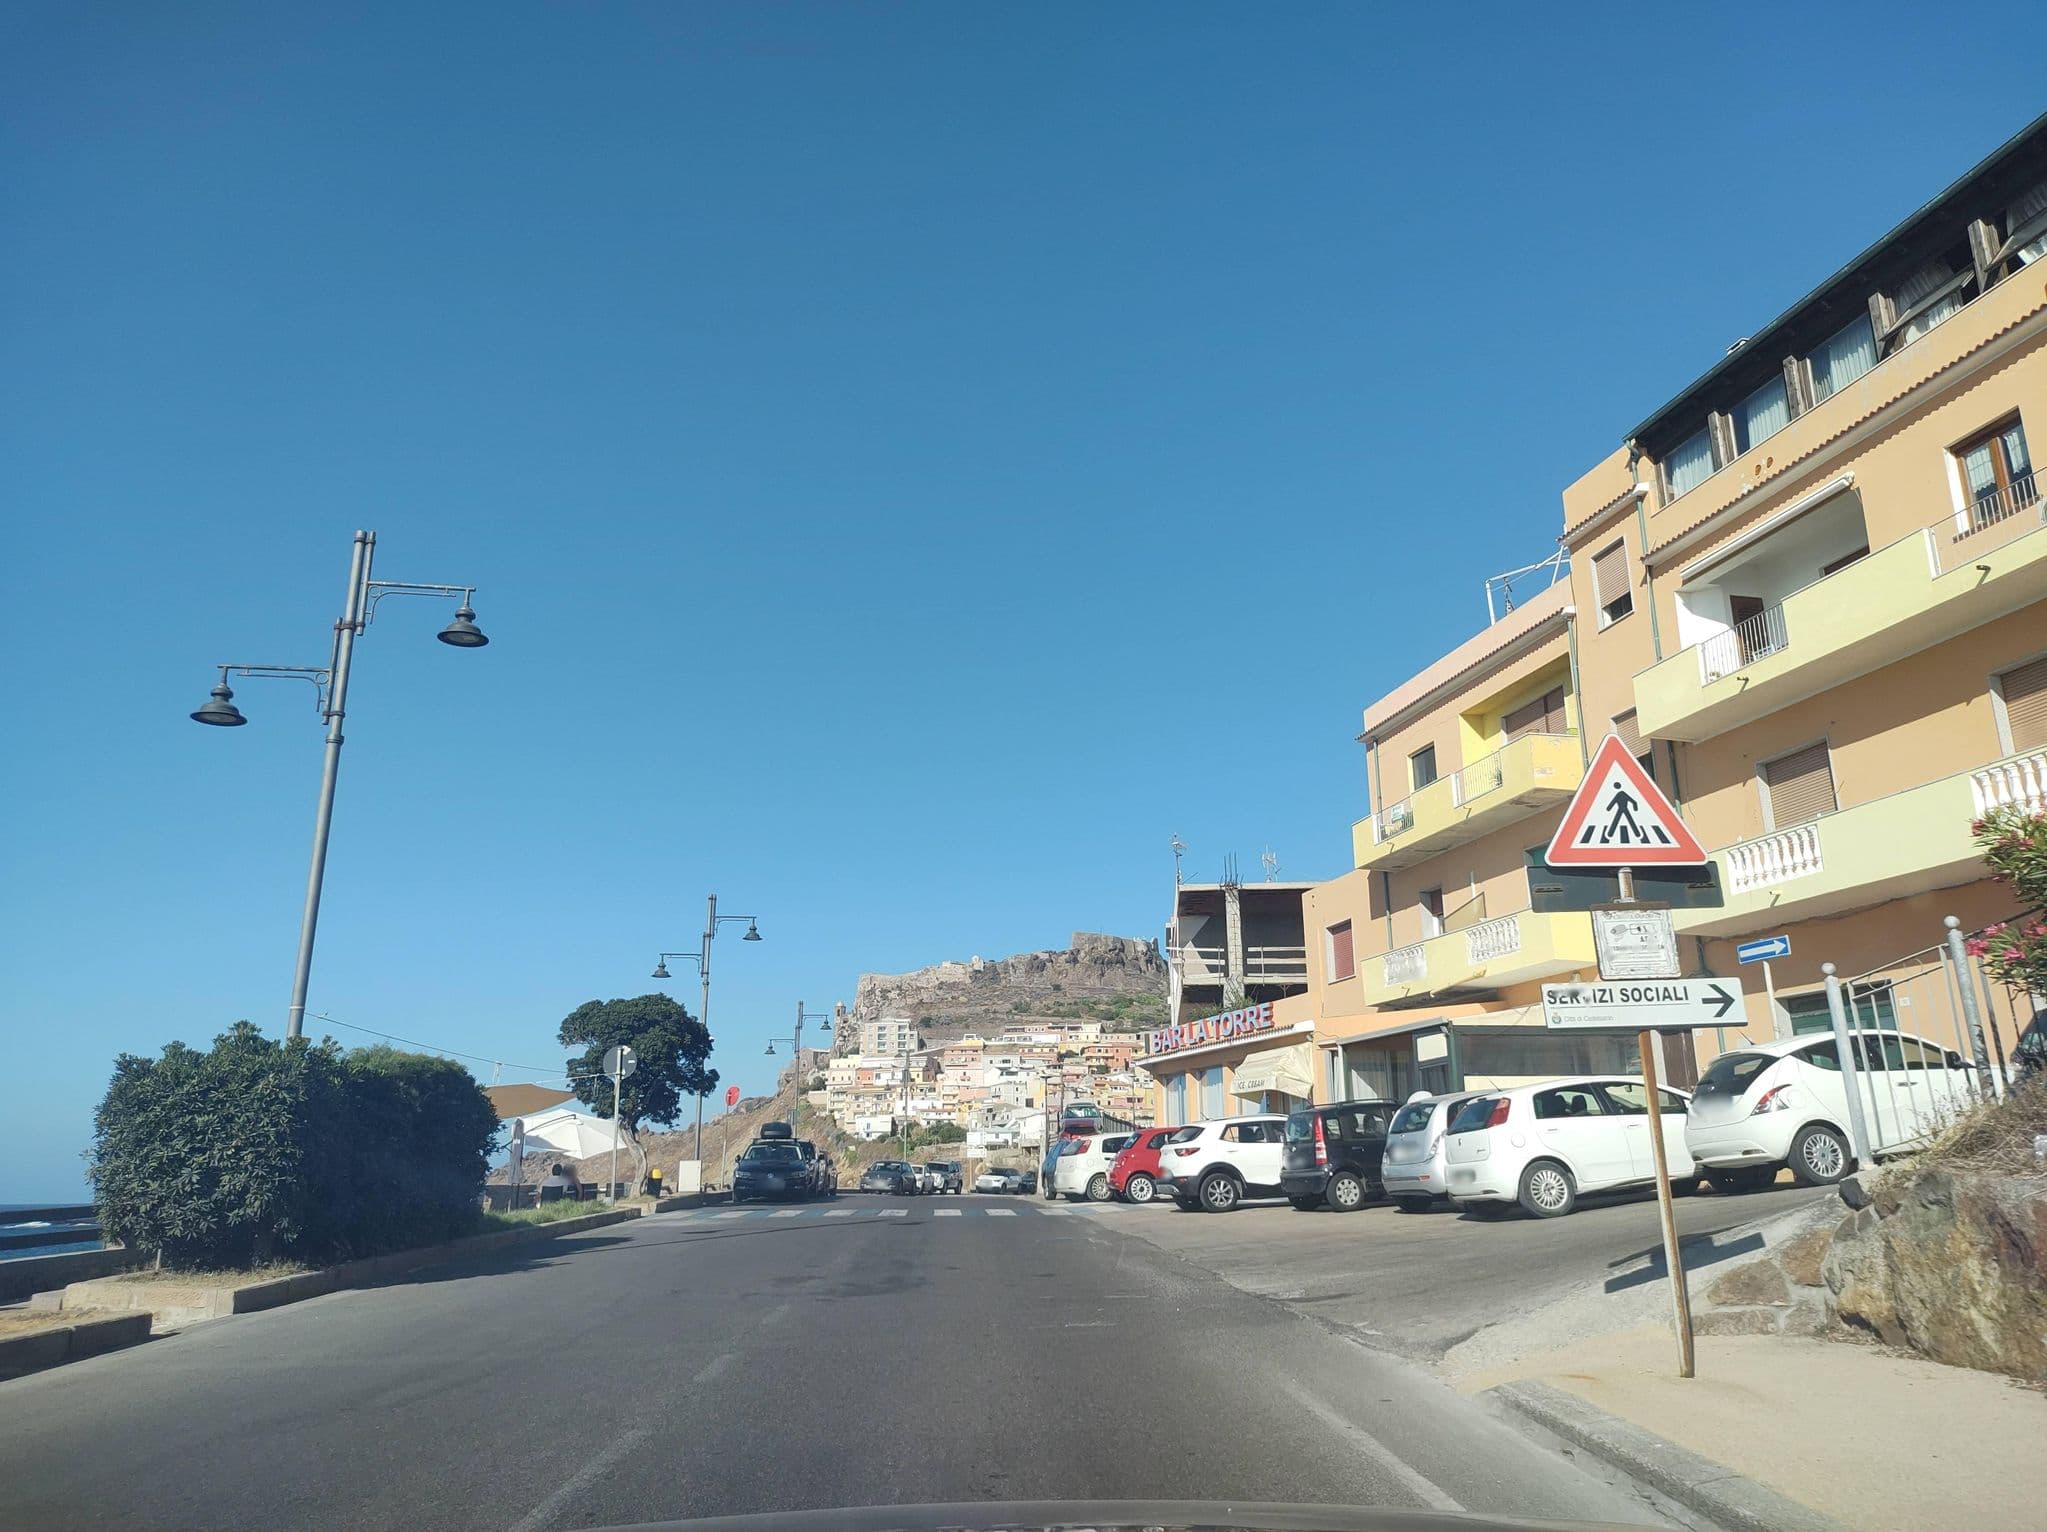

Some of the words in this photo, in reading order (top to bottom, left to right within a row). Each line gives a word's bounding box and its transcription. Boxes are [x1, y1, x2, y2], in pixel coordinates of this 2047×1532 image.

[1619, 986, 1689, 1004] SOCIALI
[1150, 1025, 1184, 1053] BAR
[1208, 1002, 1275, 1040] TORRE
